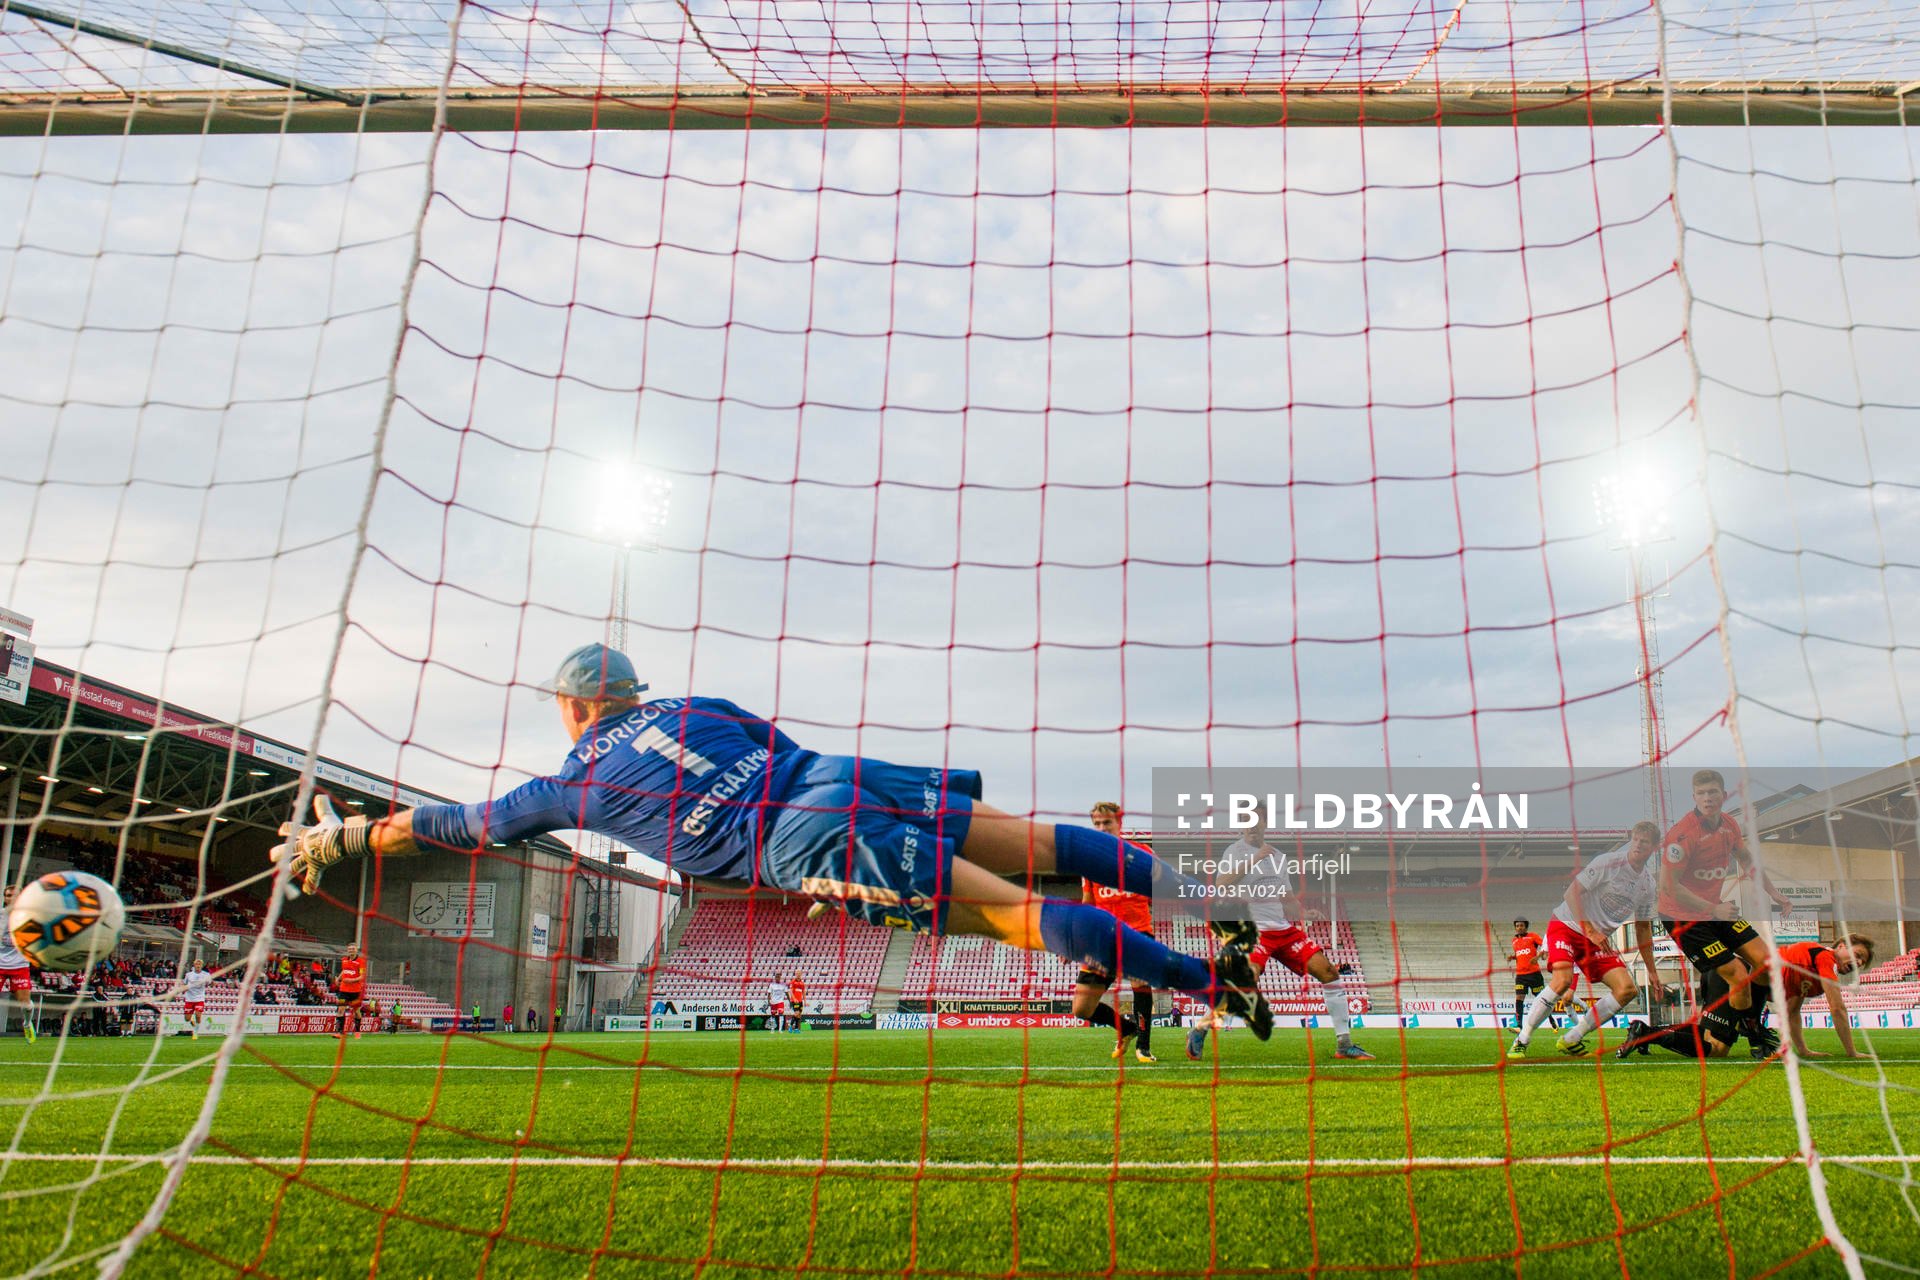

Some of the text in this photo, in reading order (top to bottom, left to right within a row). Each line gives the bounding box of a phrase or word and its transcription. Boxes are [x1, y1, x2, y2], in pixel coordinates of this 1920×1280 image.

[103, 697, 124, 711] energi
[631, 724, 717, 778] 1
[900, 836, 919, 873] SATS
[681, 1003, 755, 1013] Andersen & Mørck
[938, 1001, 959, 1013] XL
[1405, 1001, 1472, 1012] COWI COWI
[280, 1016, 328, 1024] MULTI MULTI
[967, 1016, 1011, 1026] umbro
[1707, 1012, 1729, 1026] ELIXIA
